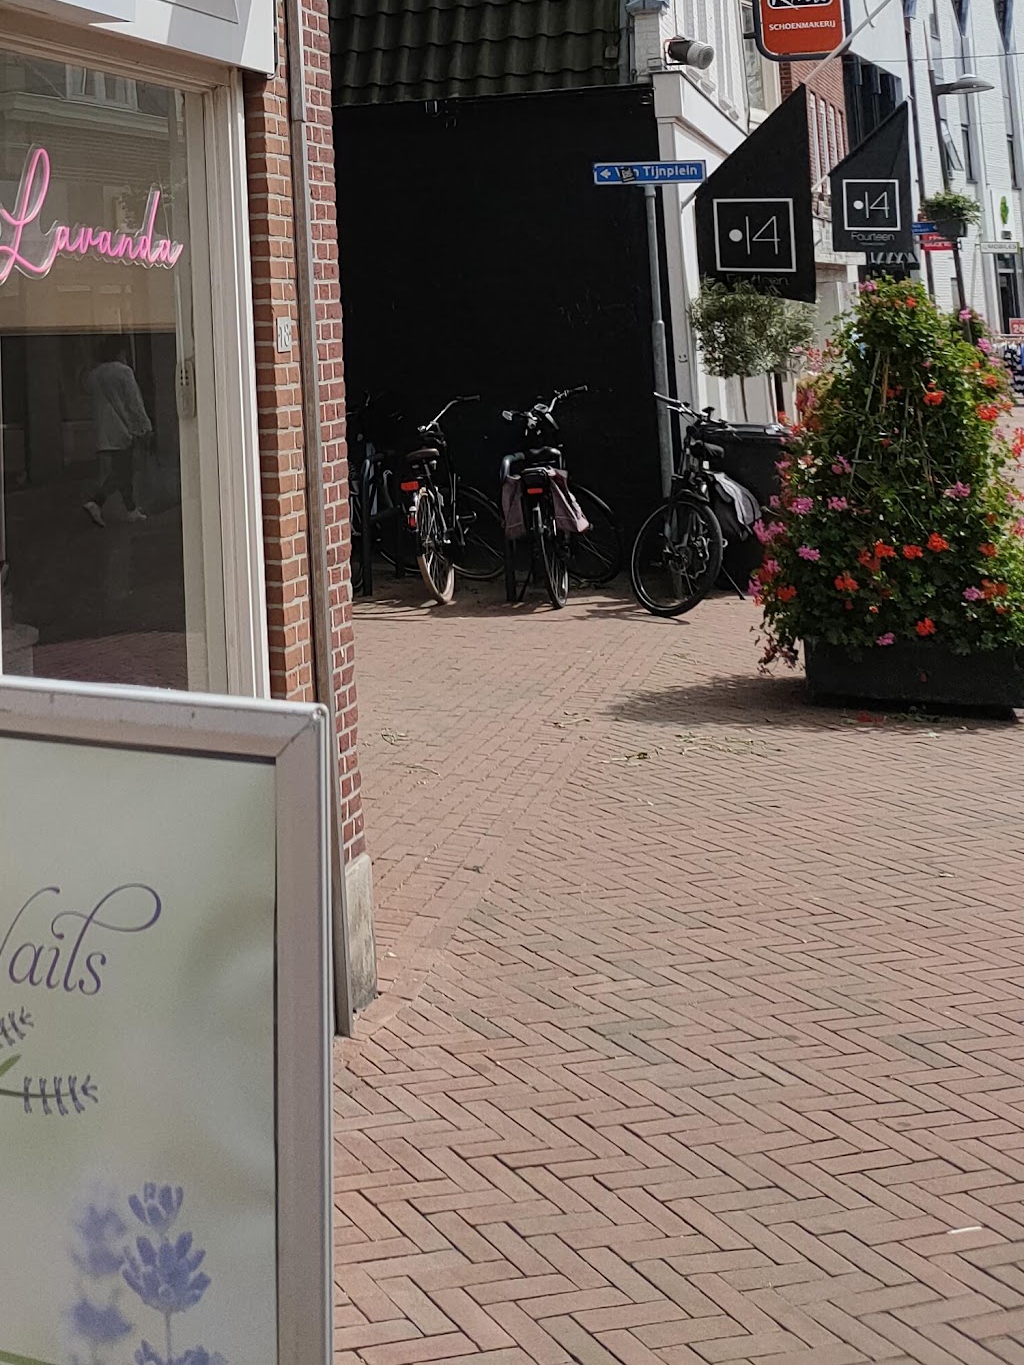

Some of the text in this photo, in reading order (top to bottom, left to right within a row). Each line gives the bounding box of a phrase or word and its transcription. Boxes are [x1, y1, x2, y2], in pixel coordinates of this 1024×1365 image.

[769, 20, 835, 30] SCHOENMAKERIJ
[615, 166, 640, 178] Vn
[642, 164, 698, 180] Tijnplein
[851, 232, 895, 241] Fourteen
